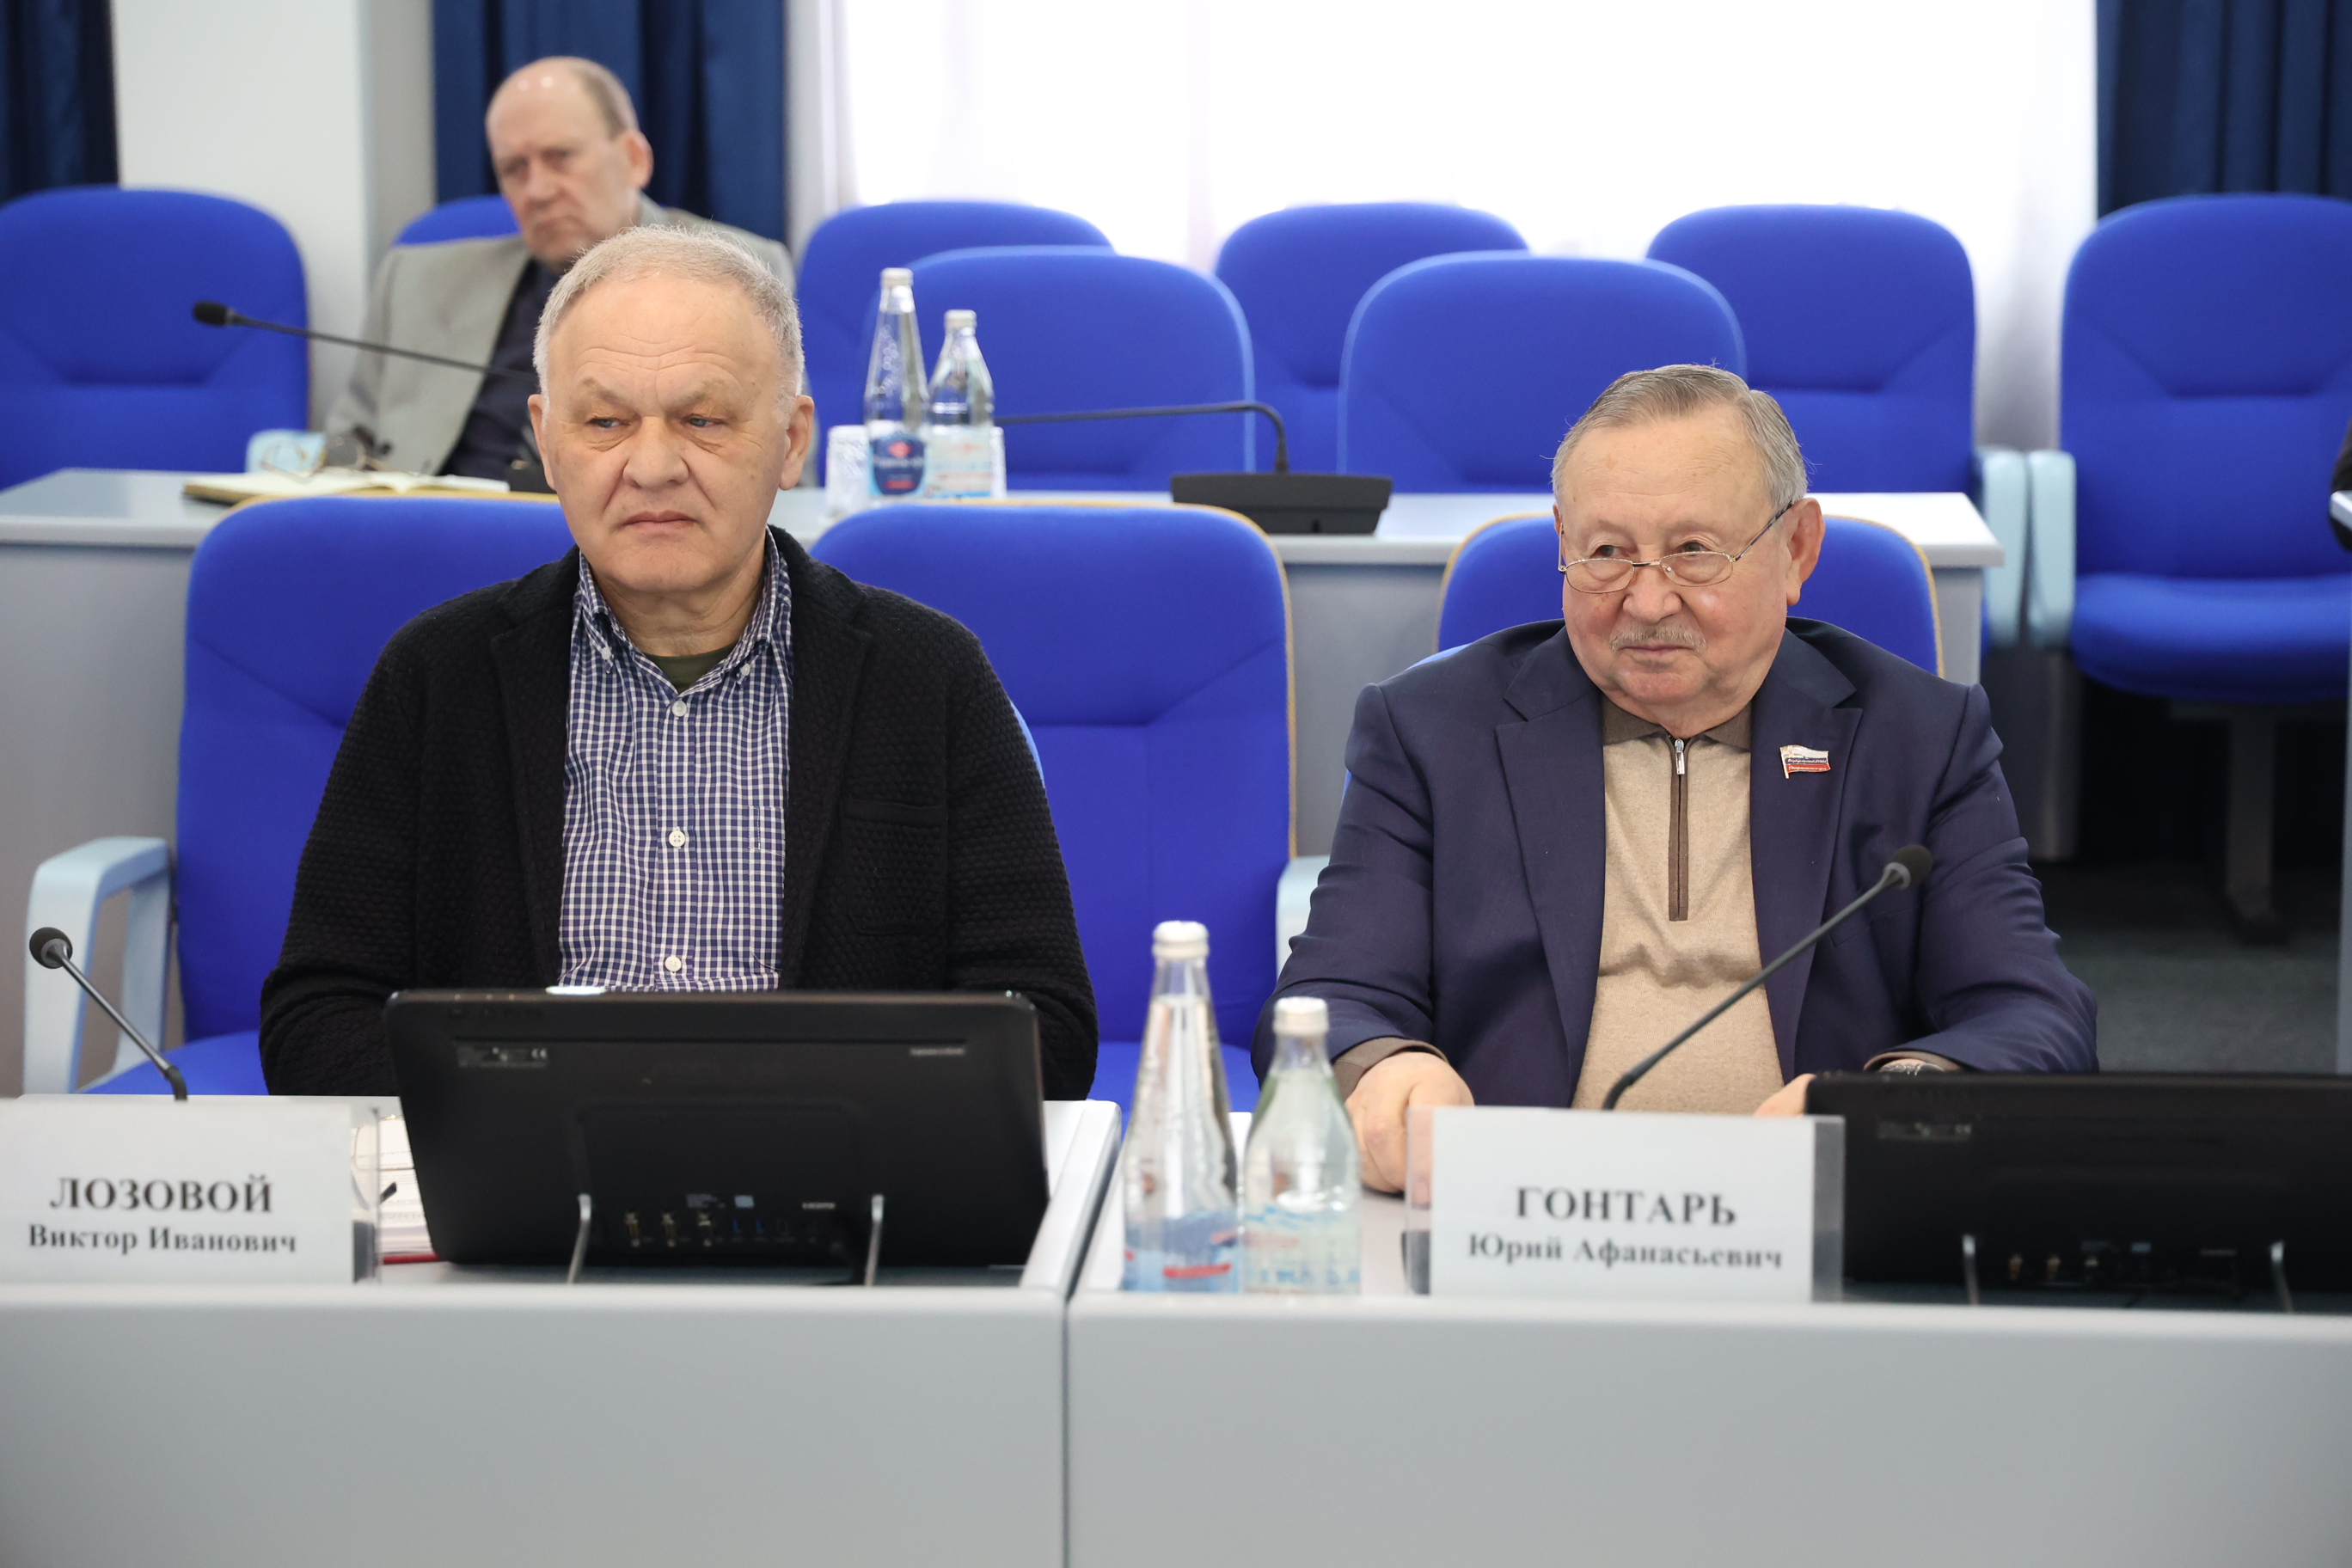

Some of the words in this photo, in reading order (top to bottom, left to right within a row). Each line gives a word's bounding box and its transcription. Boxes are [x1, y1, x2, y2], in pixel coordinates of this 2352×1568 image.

[50, 1173, 272, 1213] ЛОЗОВОЙ
[1516, 1186, 1736, 1226] ГОНТАРЬ
[29, 1223, 138, 1255] Виктор
[149, 1226, 297, 1253] Иванович
[1468, 1233, 1563, 1265] Юрий
[1575, 1239, 1782, 1269] Афанасьевич
